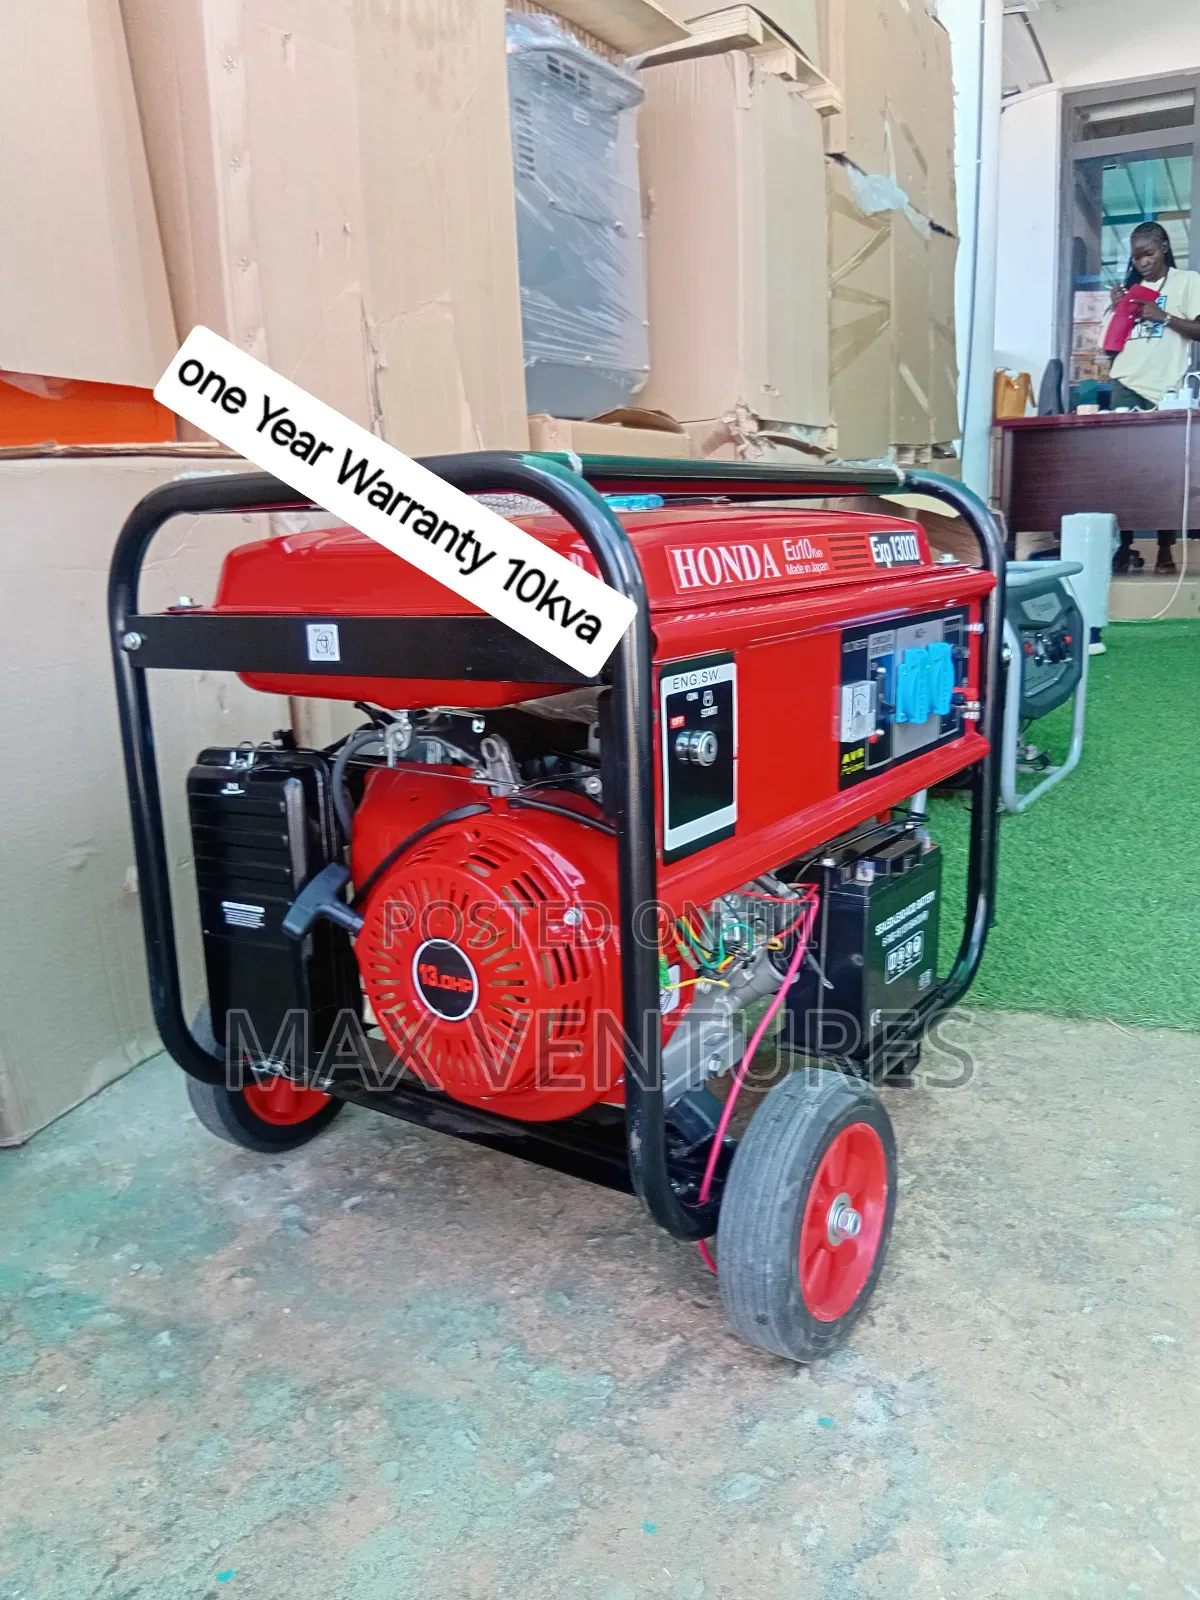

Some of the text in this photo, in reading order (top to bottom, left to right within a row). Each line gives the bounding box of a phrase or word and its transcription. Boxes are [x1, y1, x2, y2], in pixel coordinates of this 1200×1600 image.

[671, 543, 783, 589] HONDA
[785, 562, 829, 575] Made in Japan
